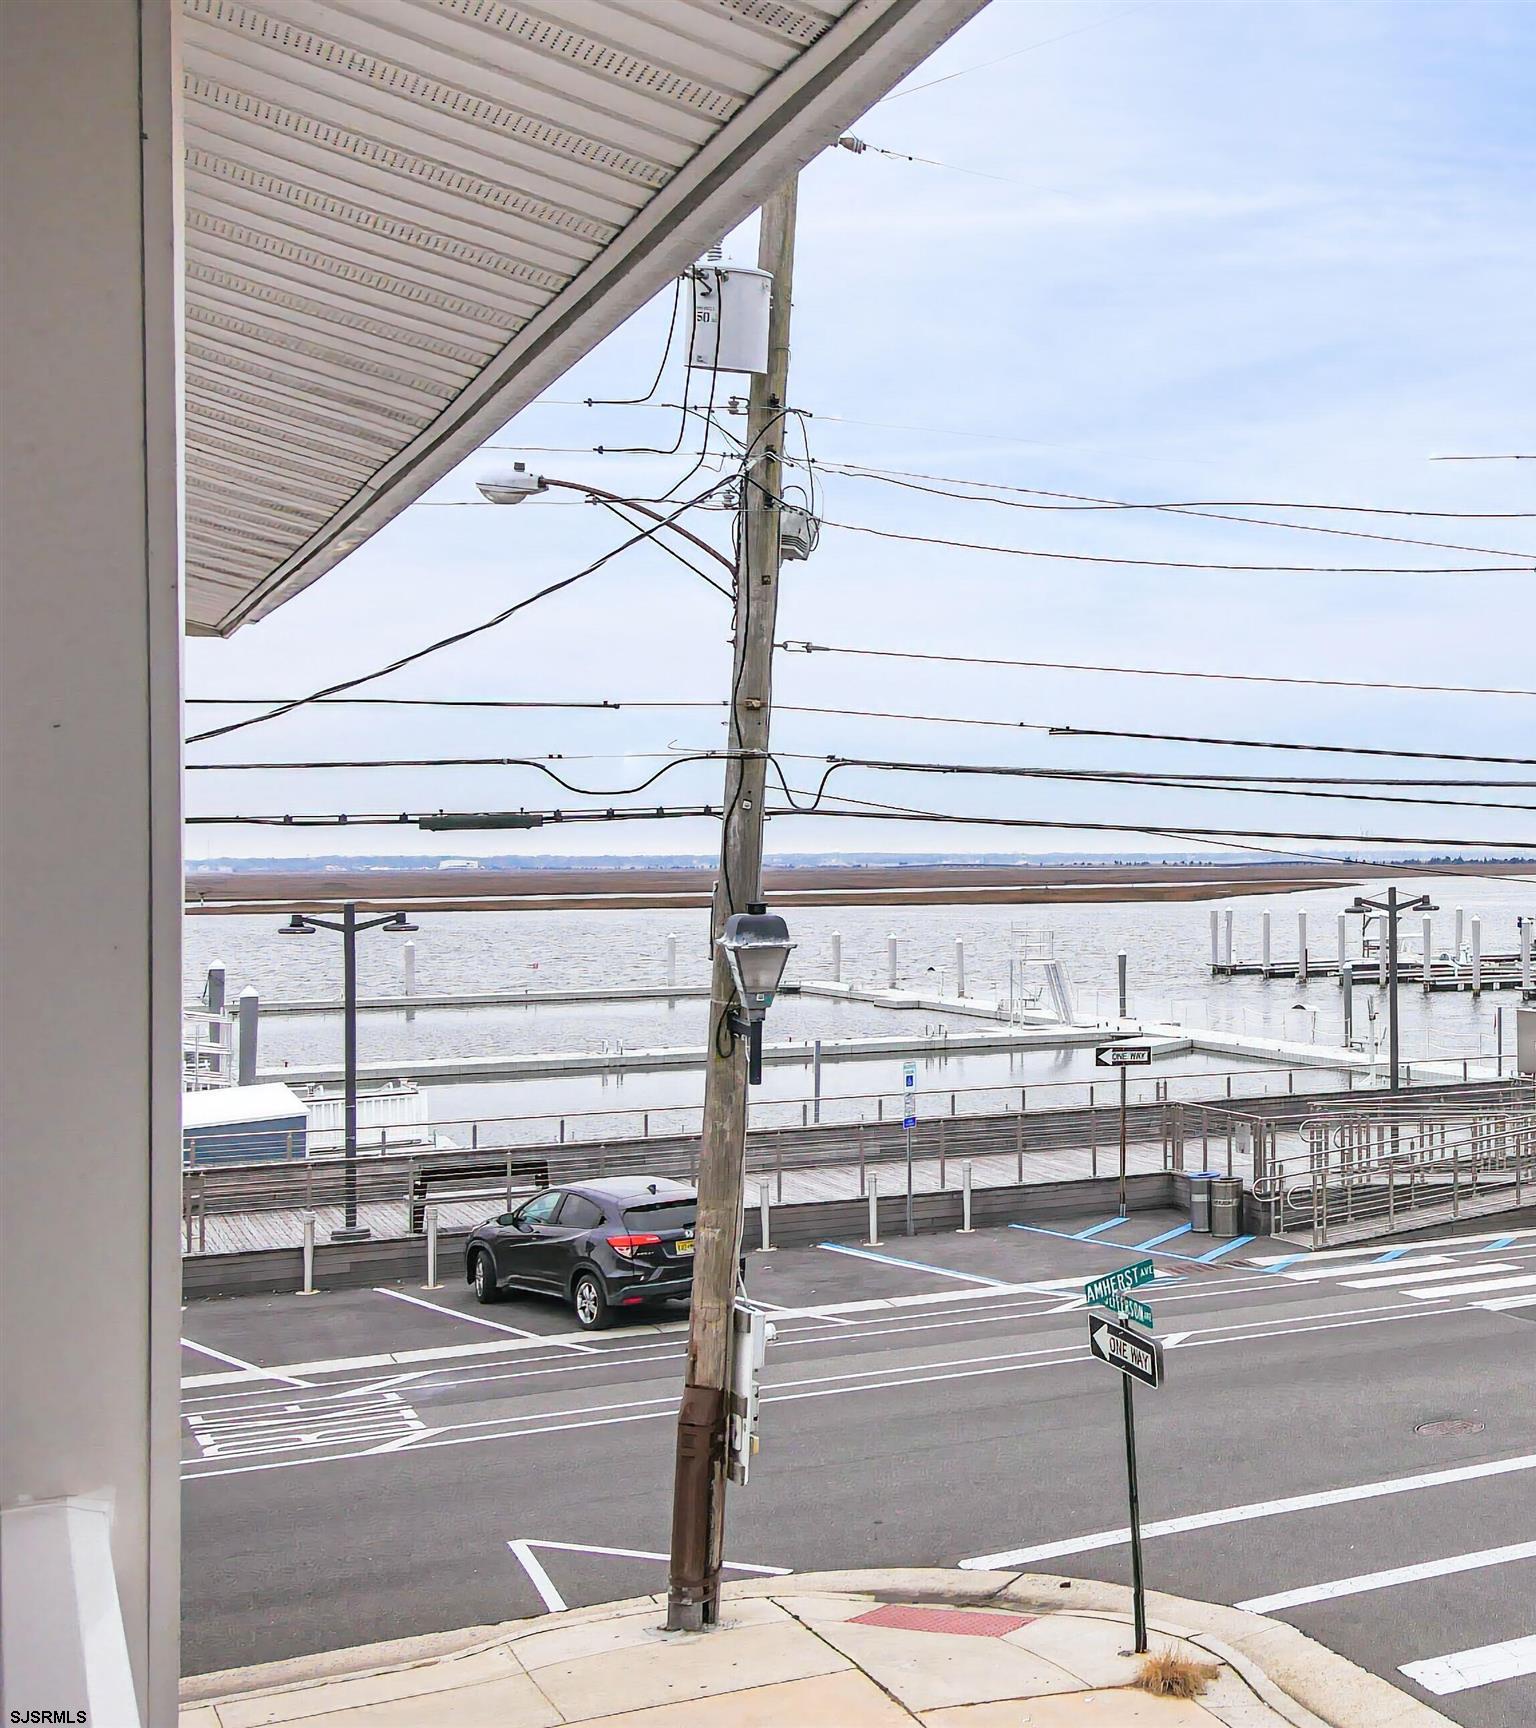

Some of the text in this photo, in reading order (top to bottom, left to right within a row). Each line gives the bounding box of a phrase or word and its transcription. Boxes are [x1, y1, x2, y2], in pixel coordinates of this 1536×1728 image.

[1112, 1052, 1146, 1061] ONE WAY
[1087, 1265, 1153, 1303] AMHERST AVE
[1109, 1337, 1149, 1370] ONE WAY
